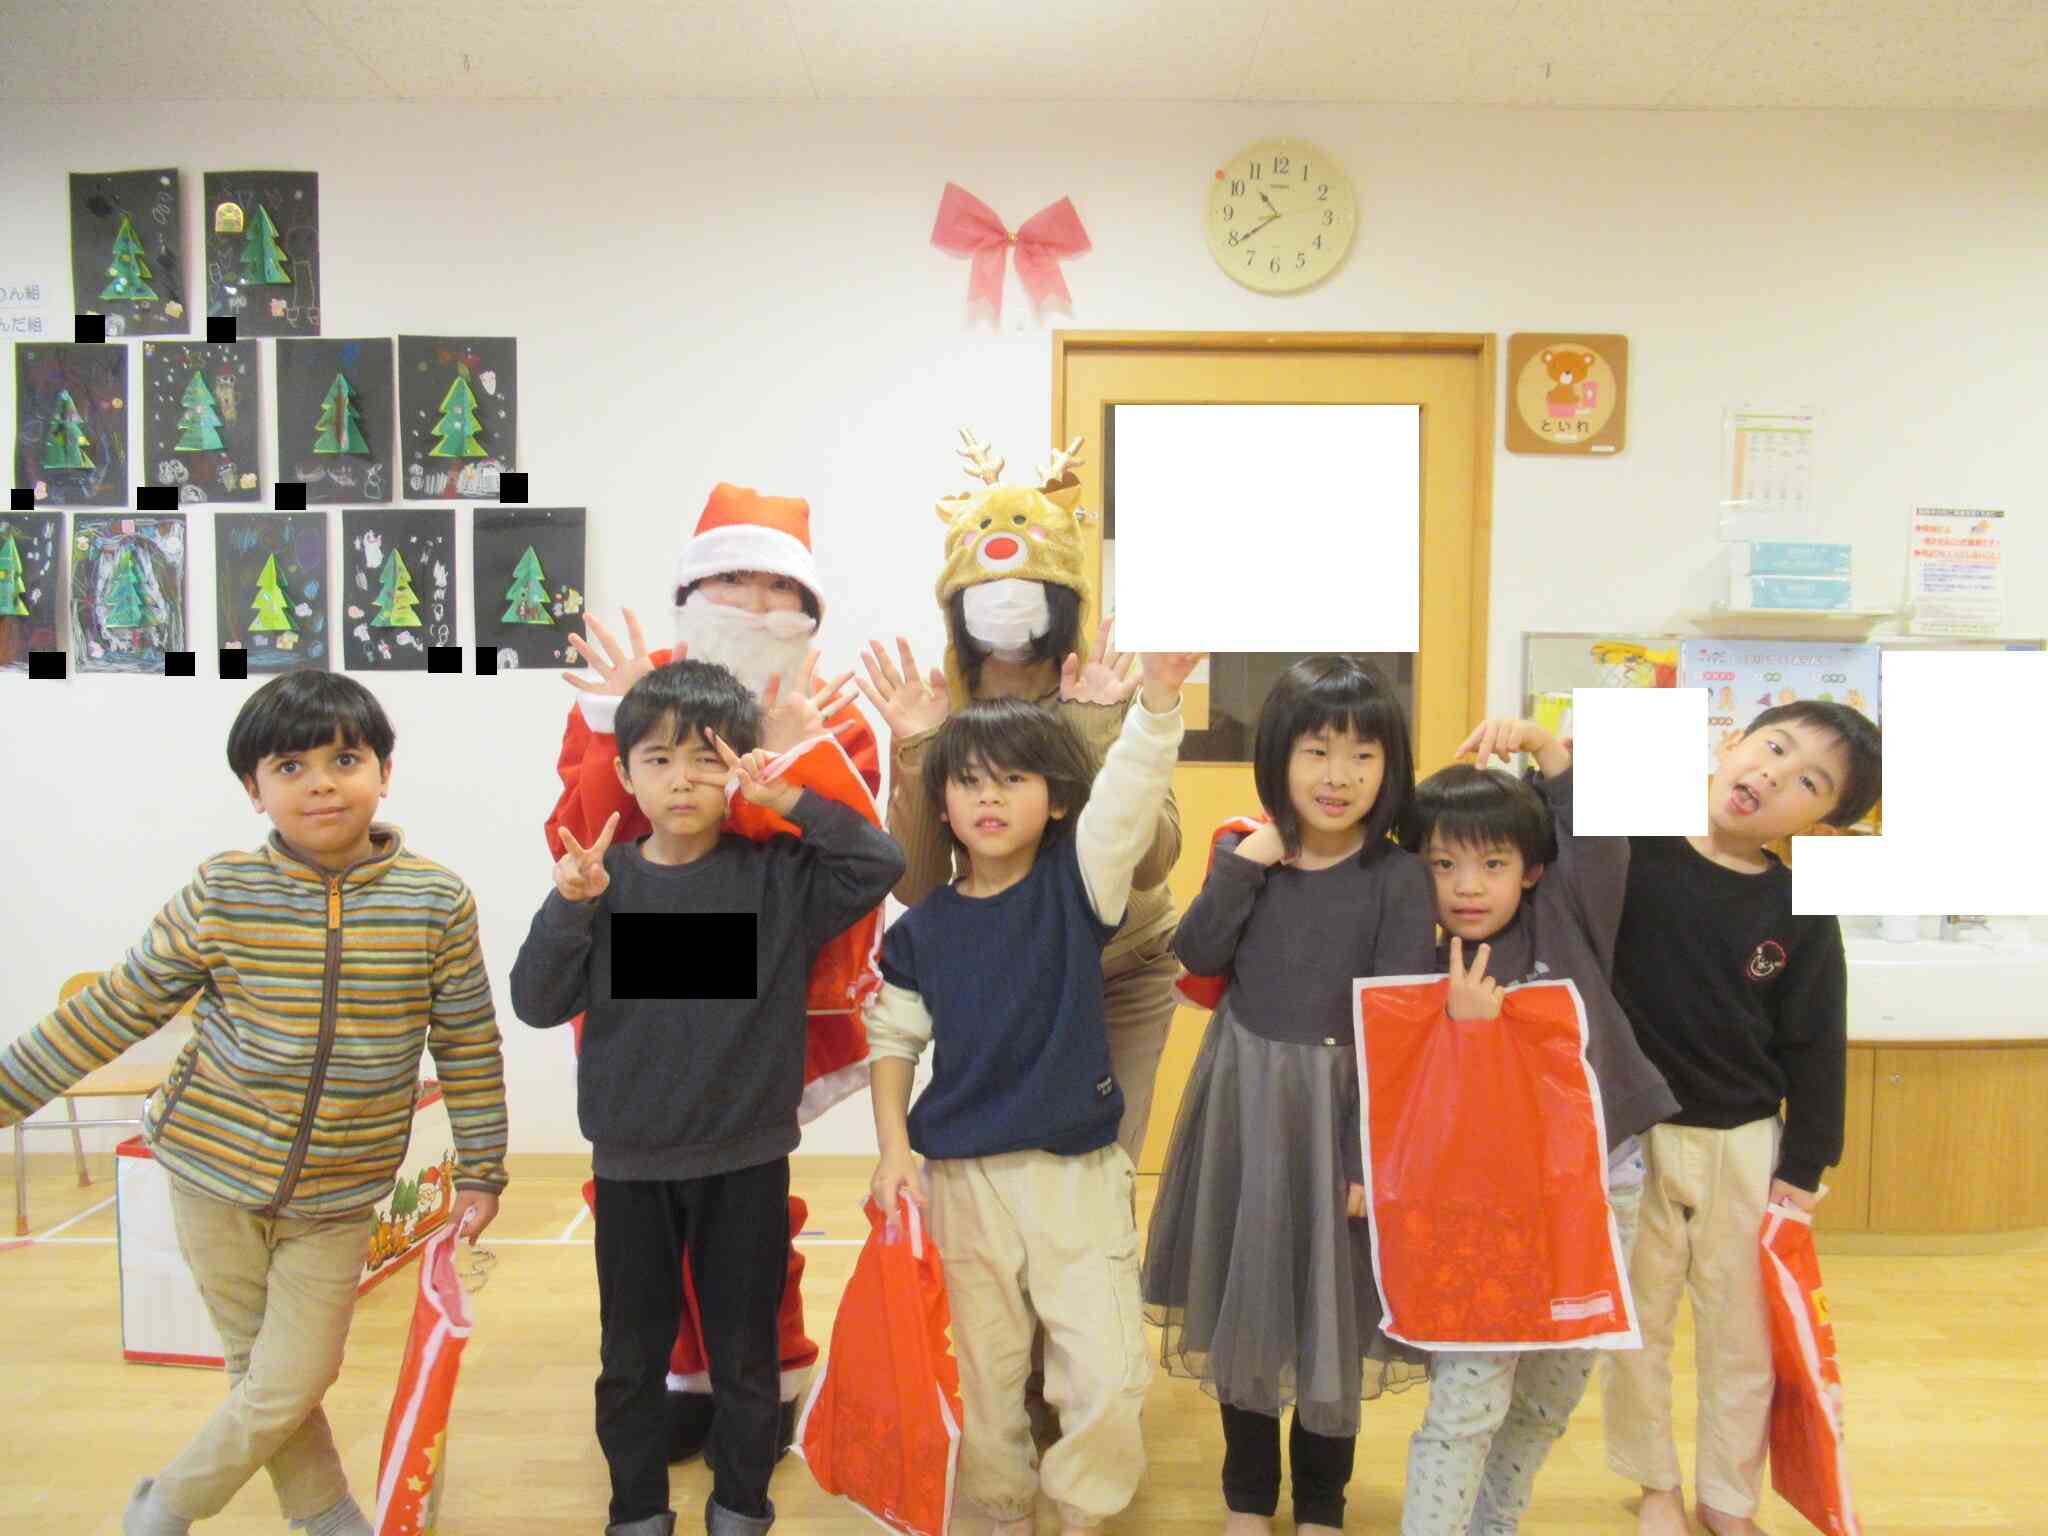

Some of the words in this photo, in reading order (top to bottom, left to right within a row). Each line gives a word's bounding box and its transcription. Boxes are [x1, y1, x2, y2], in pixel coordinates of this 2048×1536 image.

[1250, 162, 1261, 180] 11
[1273, 156, 1289, 174] 12
[1303, 164, 1308, 181] 1
[1231, 179, 1245, 197] 10
[1317, 184, 1328, 200] 2
[1223, 205, 1234, 221] 9
[1322, 210, 1333, 226] 3
[1228, 231, 1239, 247] 8
[1312, 235, 1321, 250] 4
[1246, 250, 1257, 266] 7
[1270, 257, 1280, 273] 6
[1296, 253, 1306, 268] 5
[1541, 419, 1590, 433] といれ
